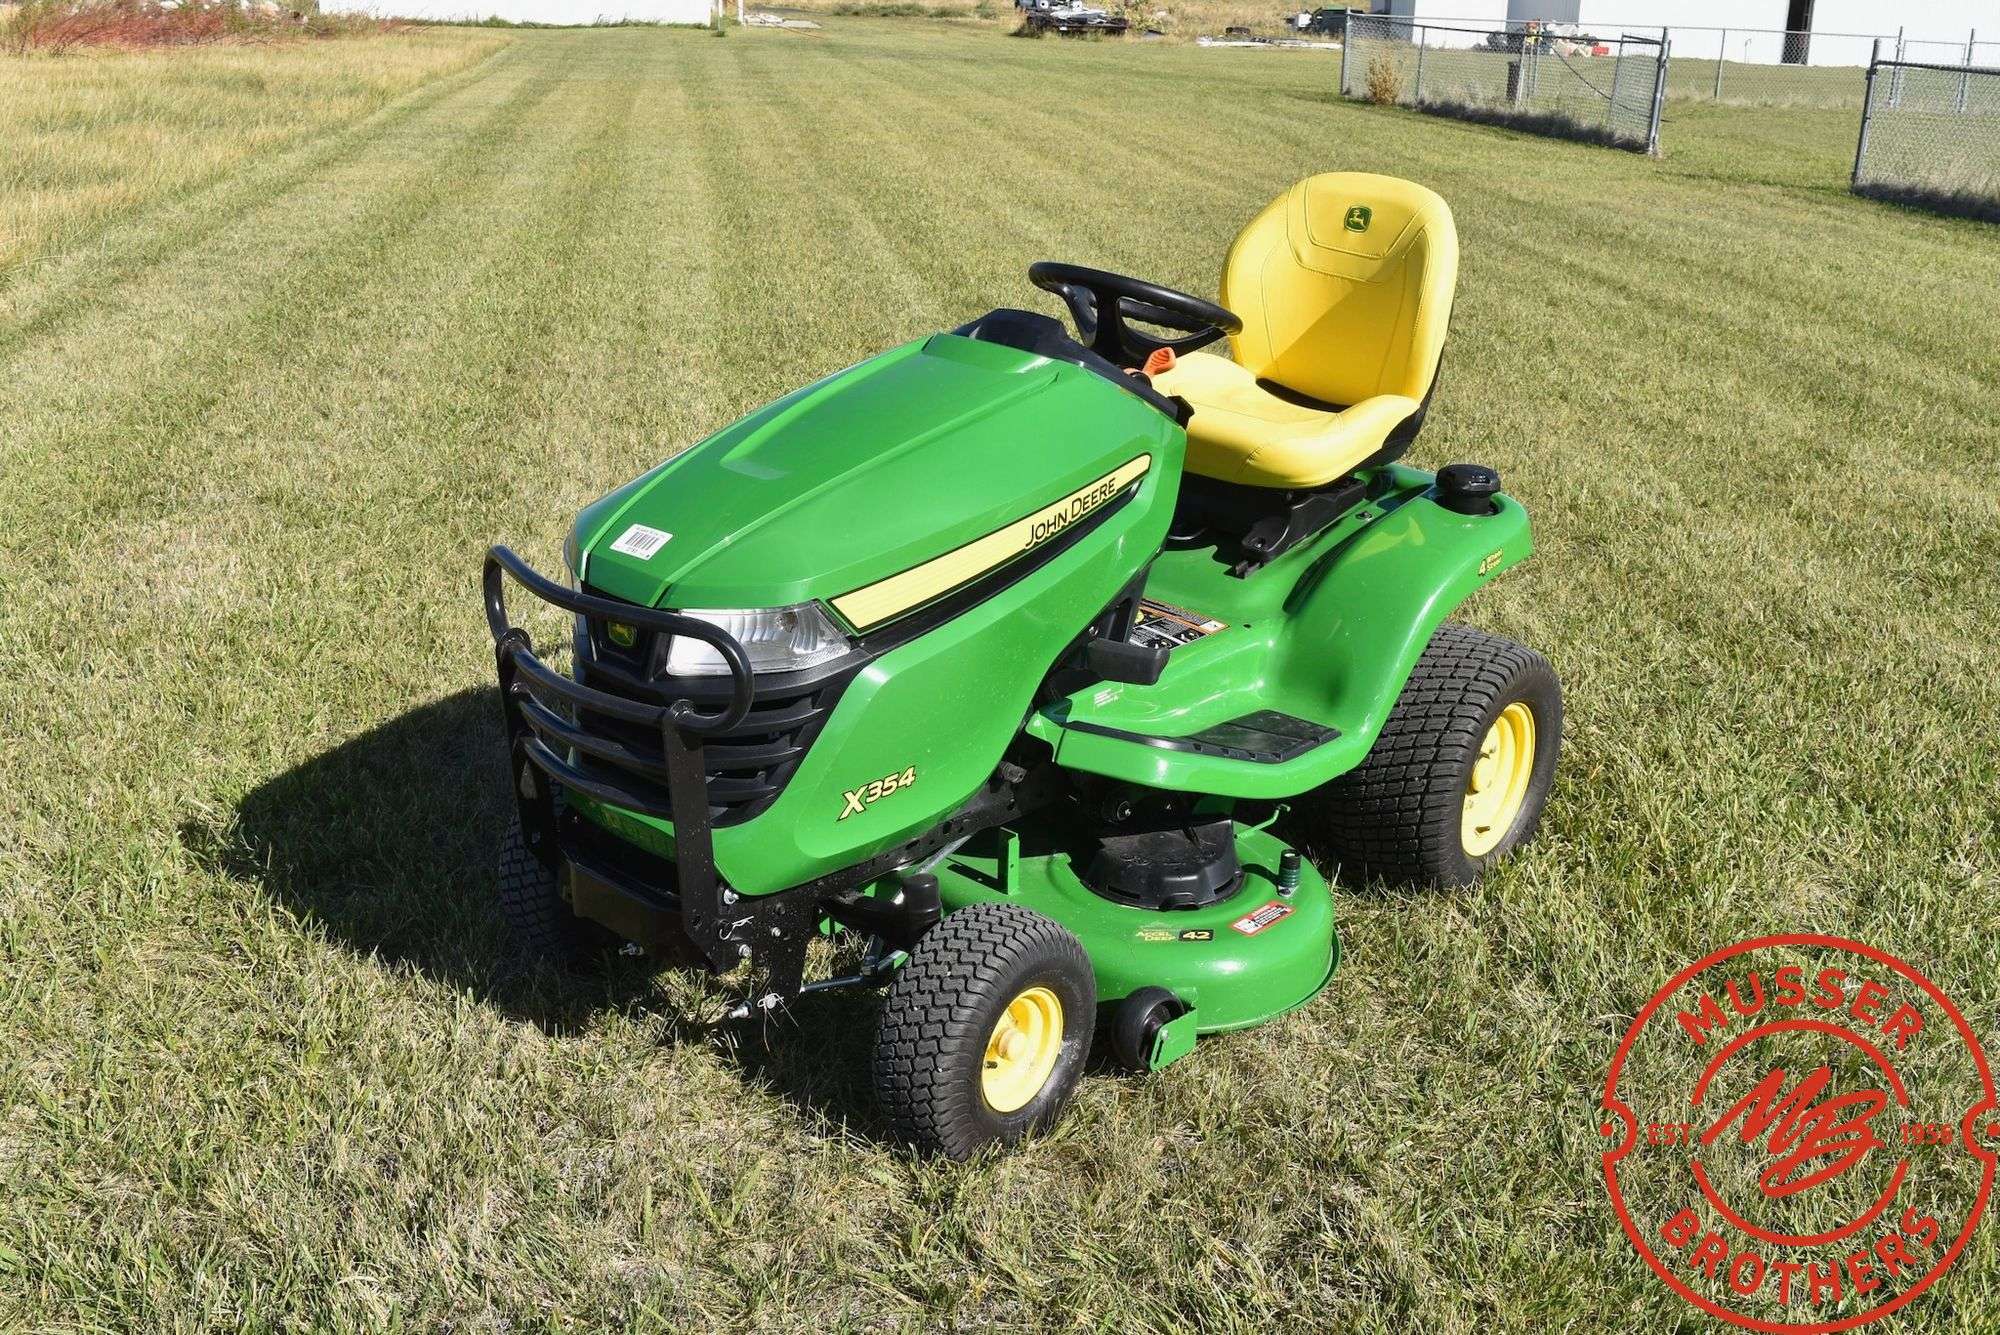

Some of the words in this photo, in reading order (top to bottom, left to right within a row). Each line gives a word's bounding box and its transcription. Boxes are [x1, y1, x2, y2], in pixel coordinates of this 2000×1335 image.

[1025, 509, 1069, 547] JOHN
[1071, 477, 1117, 519] DEERE
[836, 765, 916, 822] X354
[1181, 930, 1211, 940] 42
